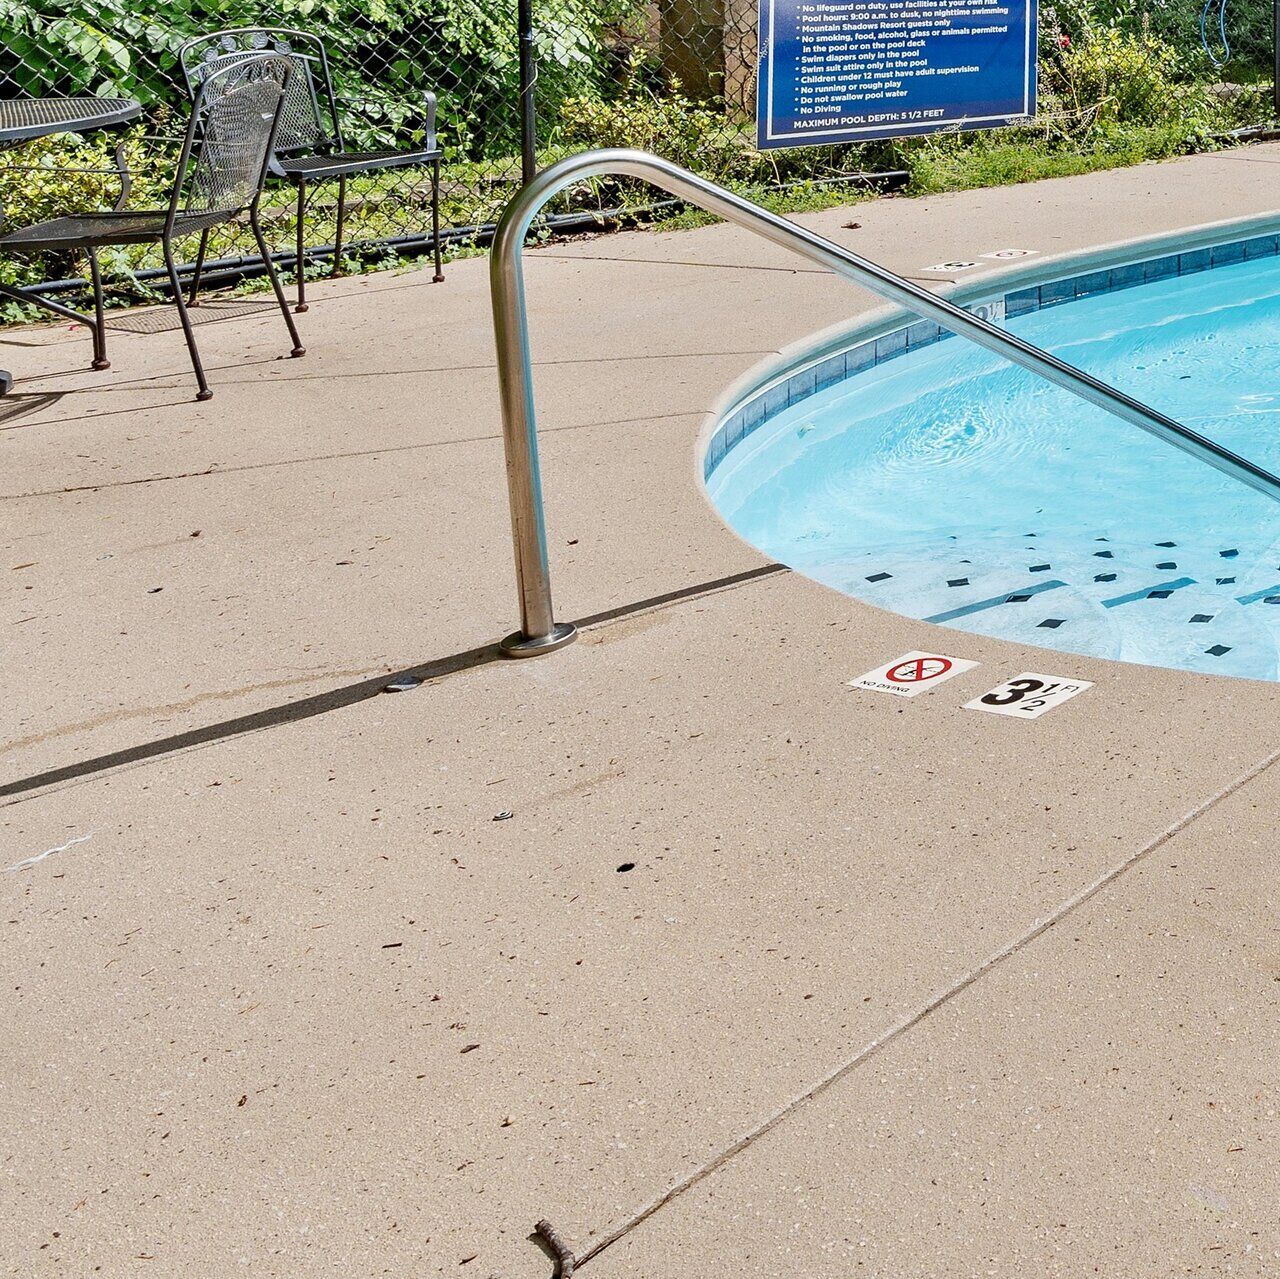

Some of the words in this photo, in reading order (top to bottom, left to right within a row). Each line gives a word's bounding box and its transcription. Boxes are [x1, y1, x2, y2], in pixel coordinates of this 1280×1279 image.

[817, 4, 853, 12] lifeguard
[949, 0, 965, 7] your
[934, 9, 970, 17] nighttime
[802, 24, 840, 32] Mountain
[934, 19, 951, 27] only
[816, 34, 853, 42] smoking,
[878, 30, 909, 38] alcohol,
[911, 30, 930, 38] glass
[971, 26, 1007, 35] permitted
[829, 44, 847, 52] pool
[887, 41, 905, 49] pool
[858, 52, 876, 61] only
[902, 50, 919, 58] pool
[843, 63, 865, 71] attire
[867, 61, 884, 70] only
[895, 59, 908, 67] the
[910, 59, 927, 68] pool
[895, 69, 913, 77] have
[916, 68, 935, 76] adult
[937, 66, 979, 75] supervision
[815, 85, 846, 93] running
[859, 82, 882, 90] rough
[831, 93, 863, 102] swallow
[865, 92, 883, 101] pool
[815, 105, 841, 113] Diving
[794, 118, 838, 128] MAXIMUM
[841, 116, 866, 124] POOL
[868, 113, 899, 122] DEPTH:
[908, 111, 921, 119] 1/2
[924, 109, 944, 117] FEET
[877, 684, 910, 693] DIVING
[981, 679, 1045, 706] 3
